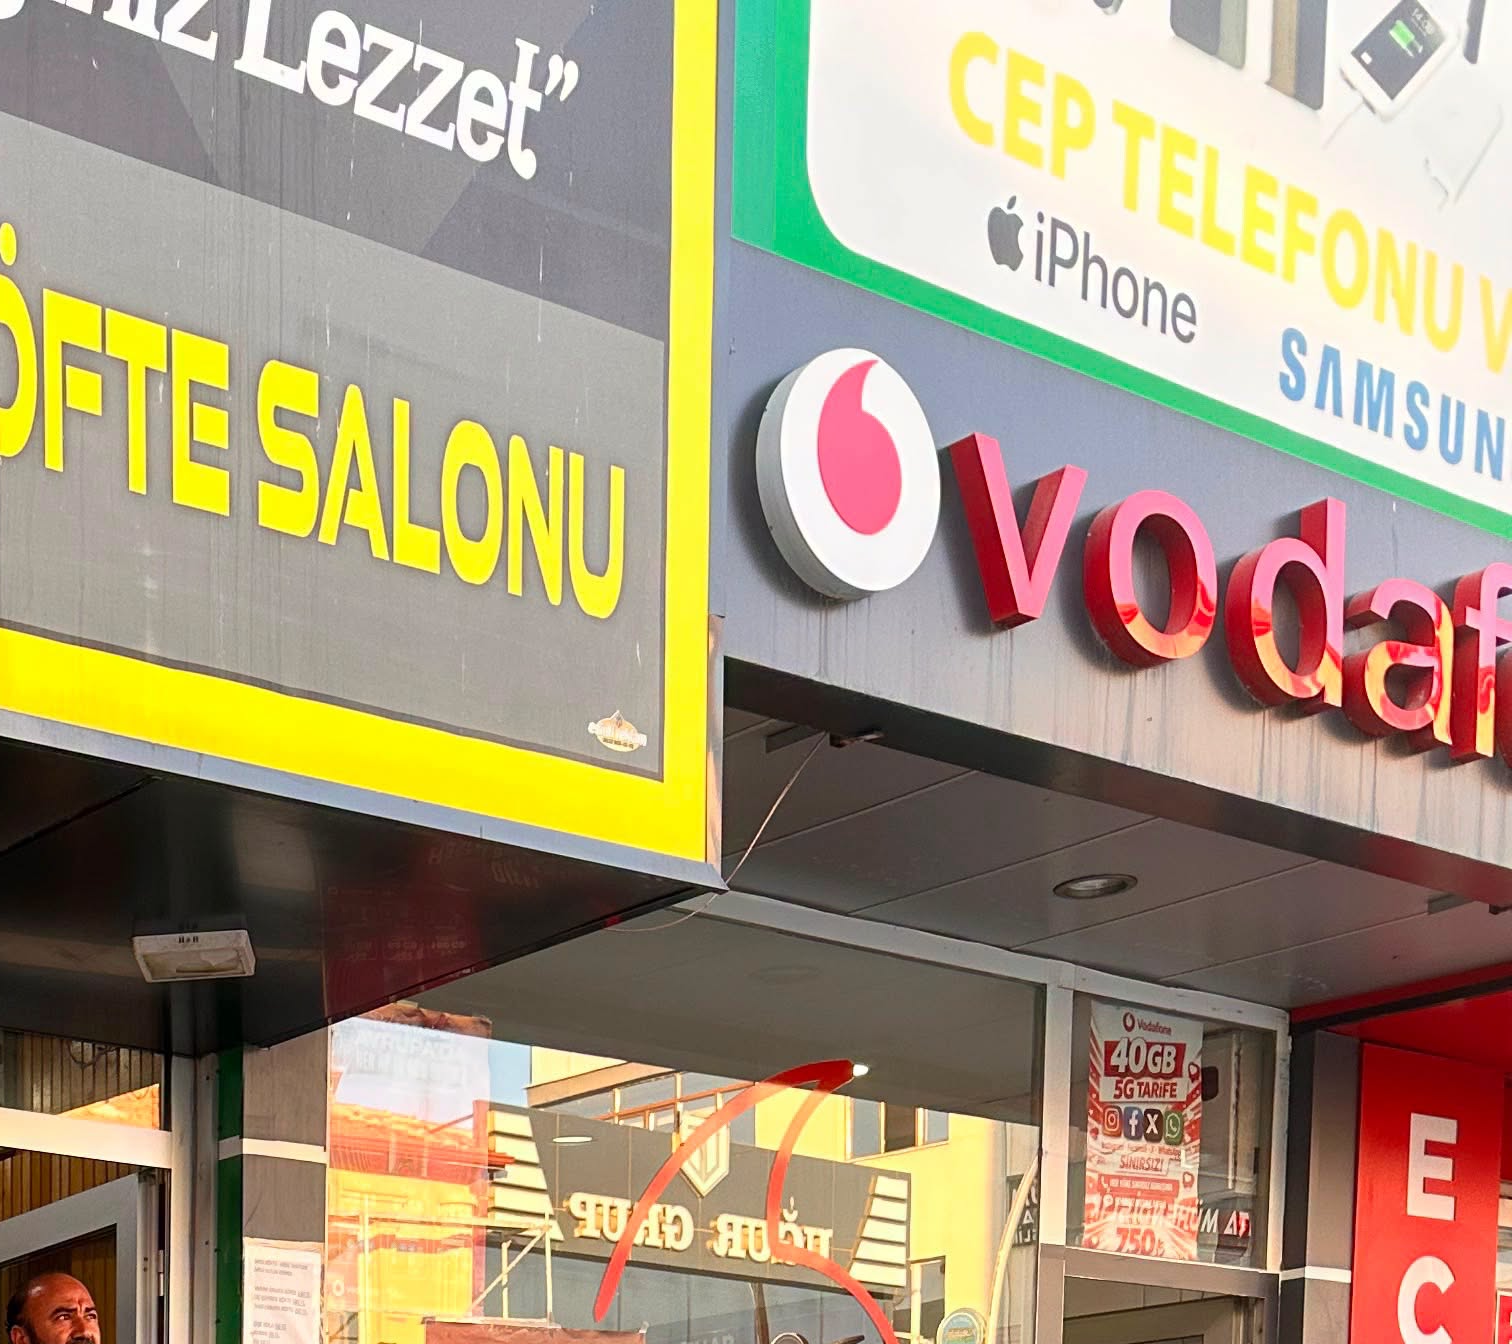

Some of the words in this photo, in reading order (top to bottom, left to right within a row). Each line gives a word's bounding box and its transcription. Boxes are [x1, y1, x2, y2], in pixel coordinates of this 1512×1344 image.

[949, 31, 1095, 181] CEP
[1112, 100, 1464, 353] TELEFONU
[1034, 212, 1198, 344] iPhone
[1279, 327, 1506, 481] SAMSUN
[258, 360, 625, 619] SALONU
[1110, 1037, 1177, 1074] 40GB
[1113, 1078, 1135, 1099] 5G
